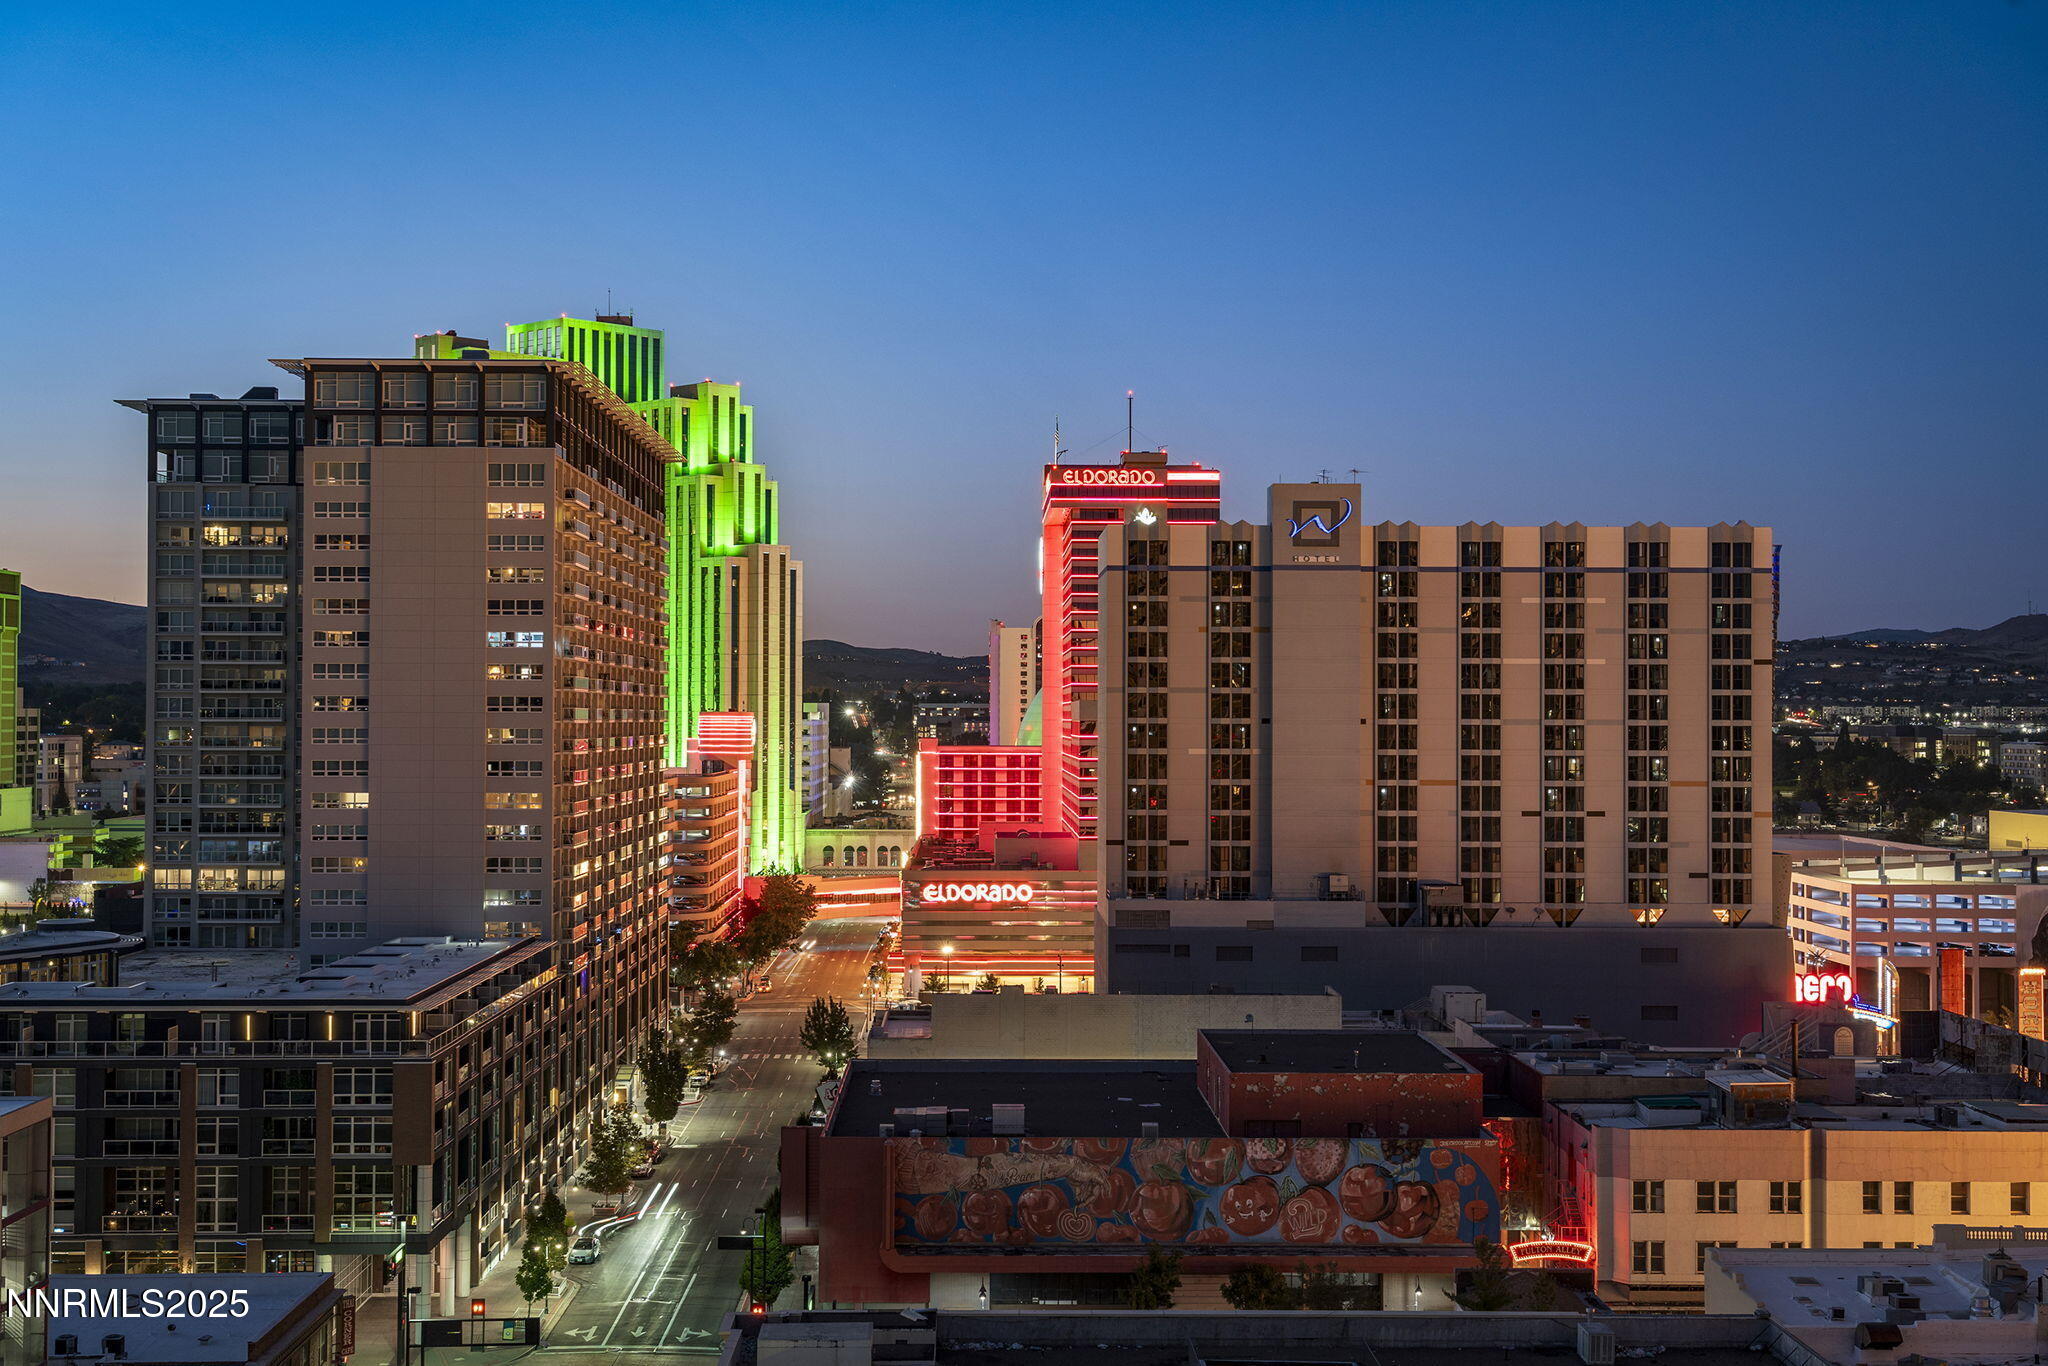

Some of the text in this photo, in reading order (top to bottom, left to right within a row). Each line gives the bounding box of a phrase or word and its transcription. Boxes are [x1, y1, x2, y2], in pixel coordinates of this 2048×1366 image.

[1063, 469, 1155, 484] ELDORADO
[1292, 555, 1340, 564] HOTEL
[923, 883, 1033, 902] ELDORADO
[1520, 1245, 1583, 1256] FULTON ALLEY
